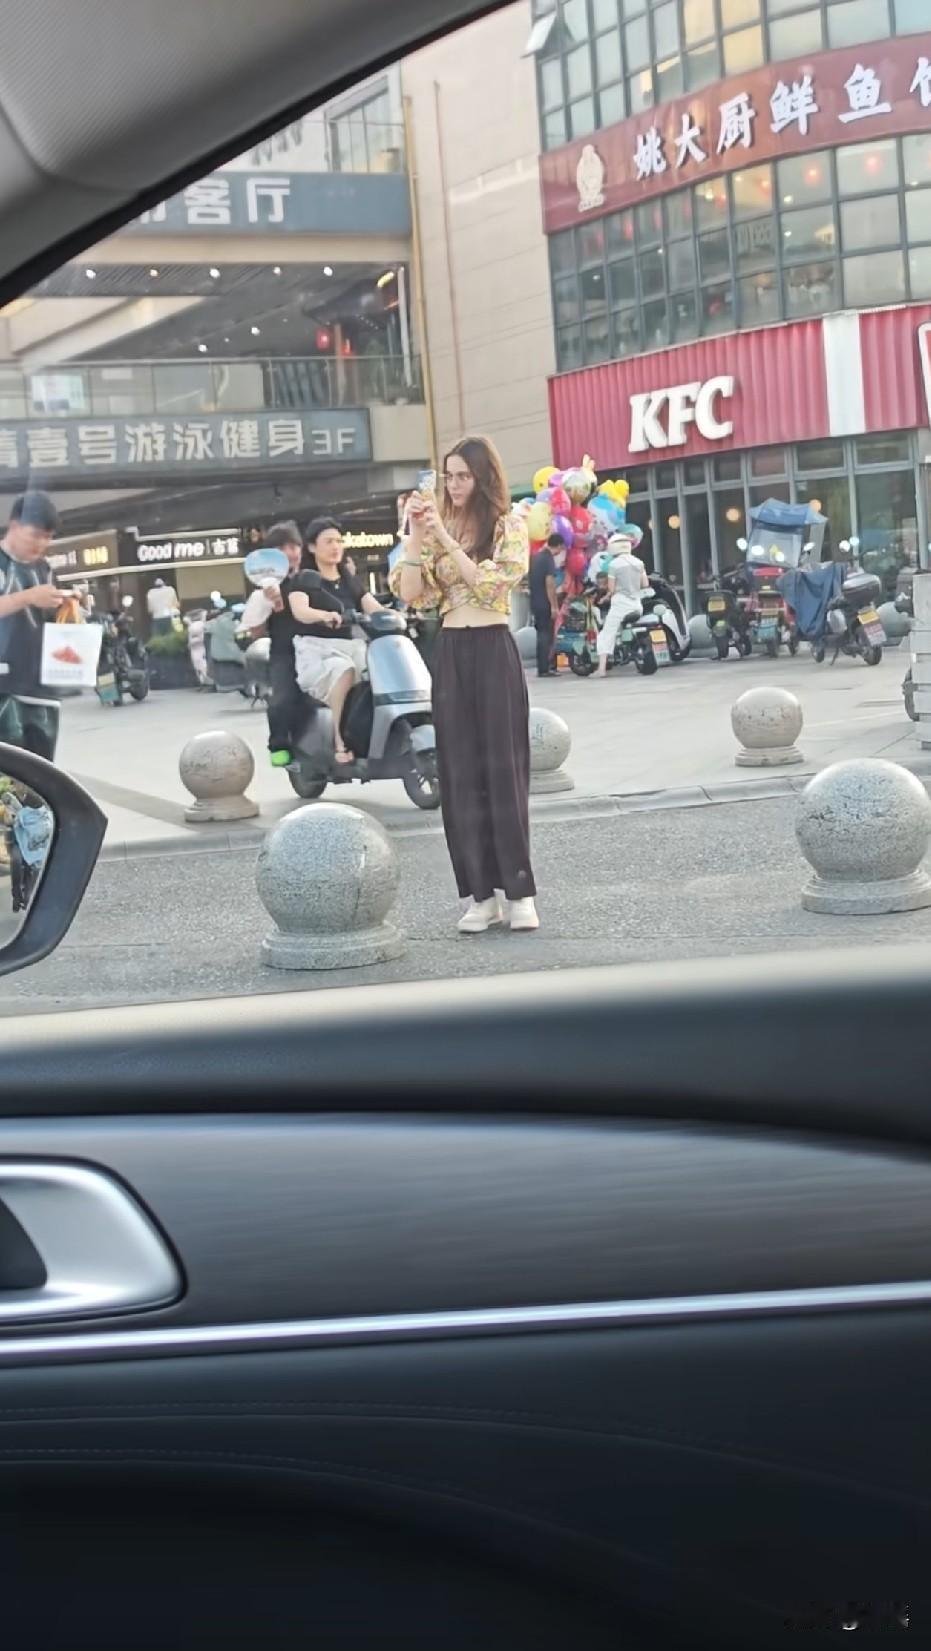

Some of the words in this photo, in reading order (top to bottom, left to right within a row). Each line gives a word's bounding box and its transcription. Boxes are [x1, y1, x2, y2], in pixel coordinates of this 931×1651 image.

[140, 177, 291, 225] 客厅
[628, 375, 734, 452] KFC
[137, 542, 172, 562] Good
[173, 542, 205, 558] me
